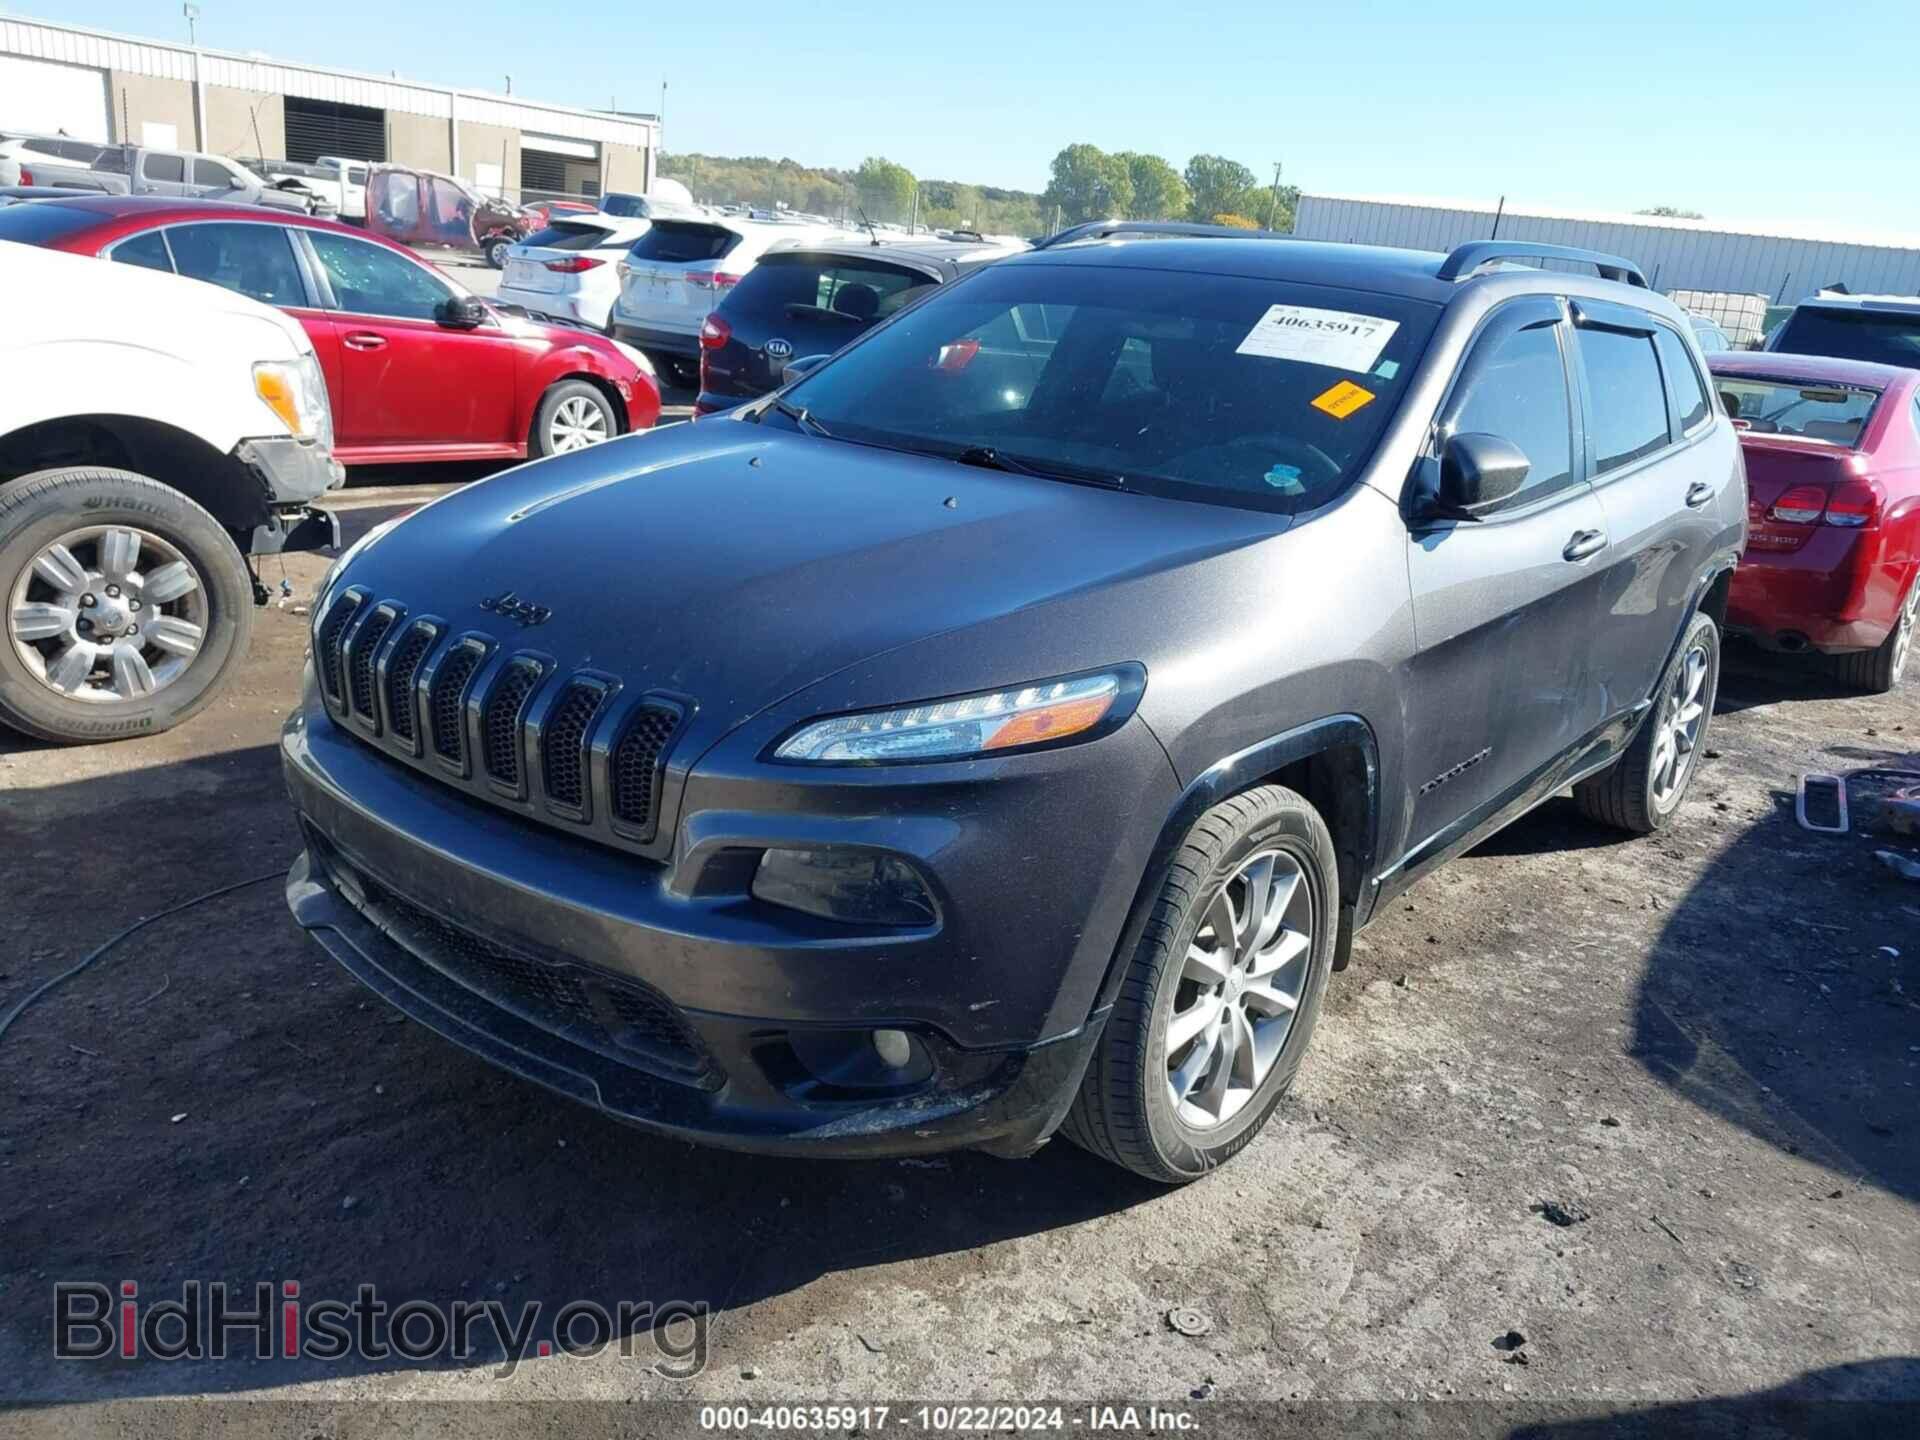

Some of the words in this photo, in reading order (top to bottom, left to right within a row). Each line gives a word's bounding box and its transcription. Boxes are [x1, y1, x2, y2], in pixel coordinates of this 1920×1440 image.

[1271, 316, 1376, 338] 40635917
[768, 341, 788, 354] KIA
[480, 592, 552, 626] Jeep
